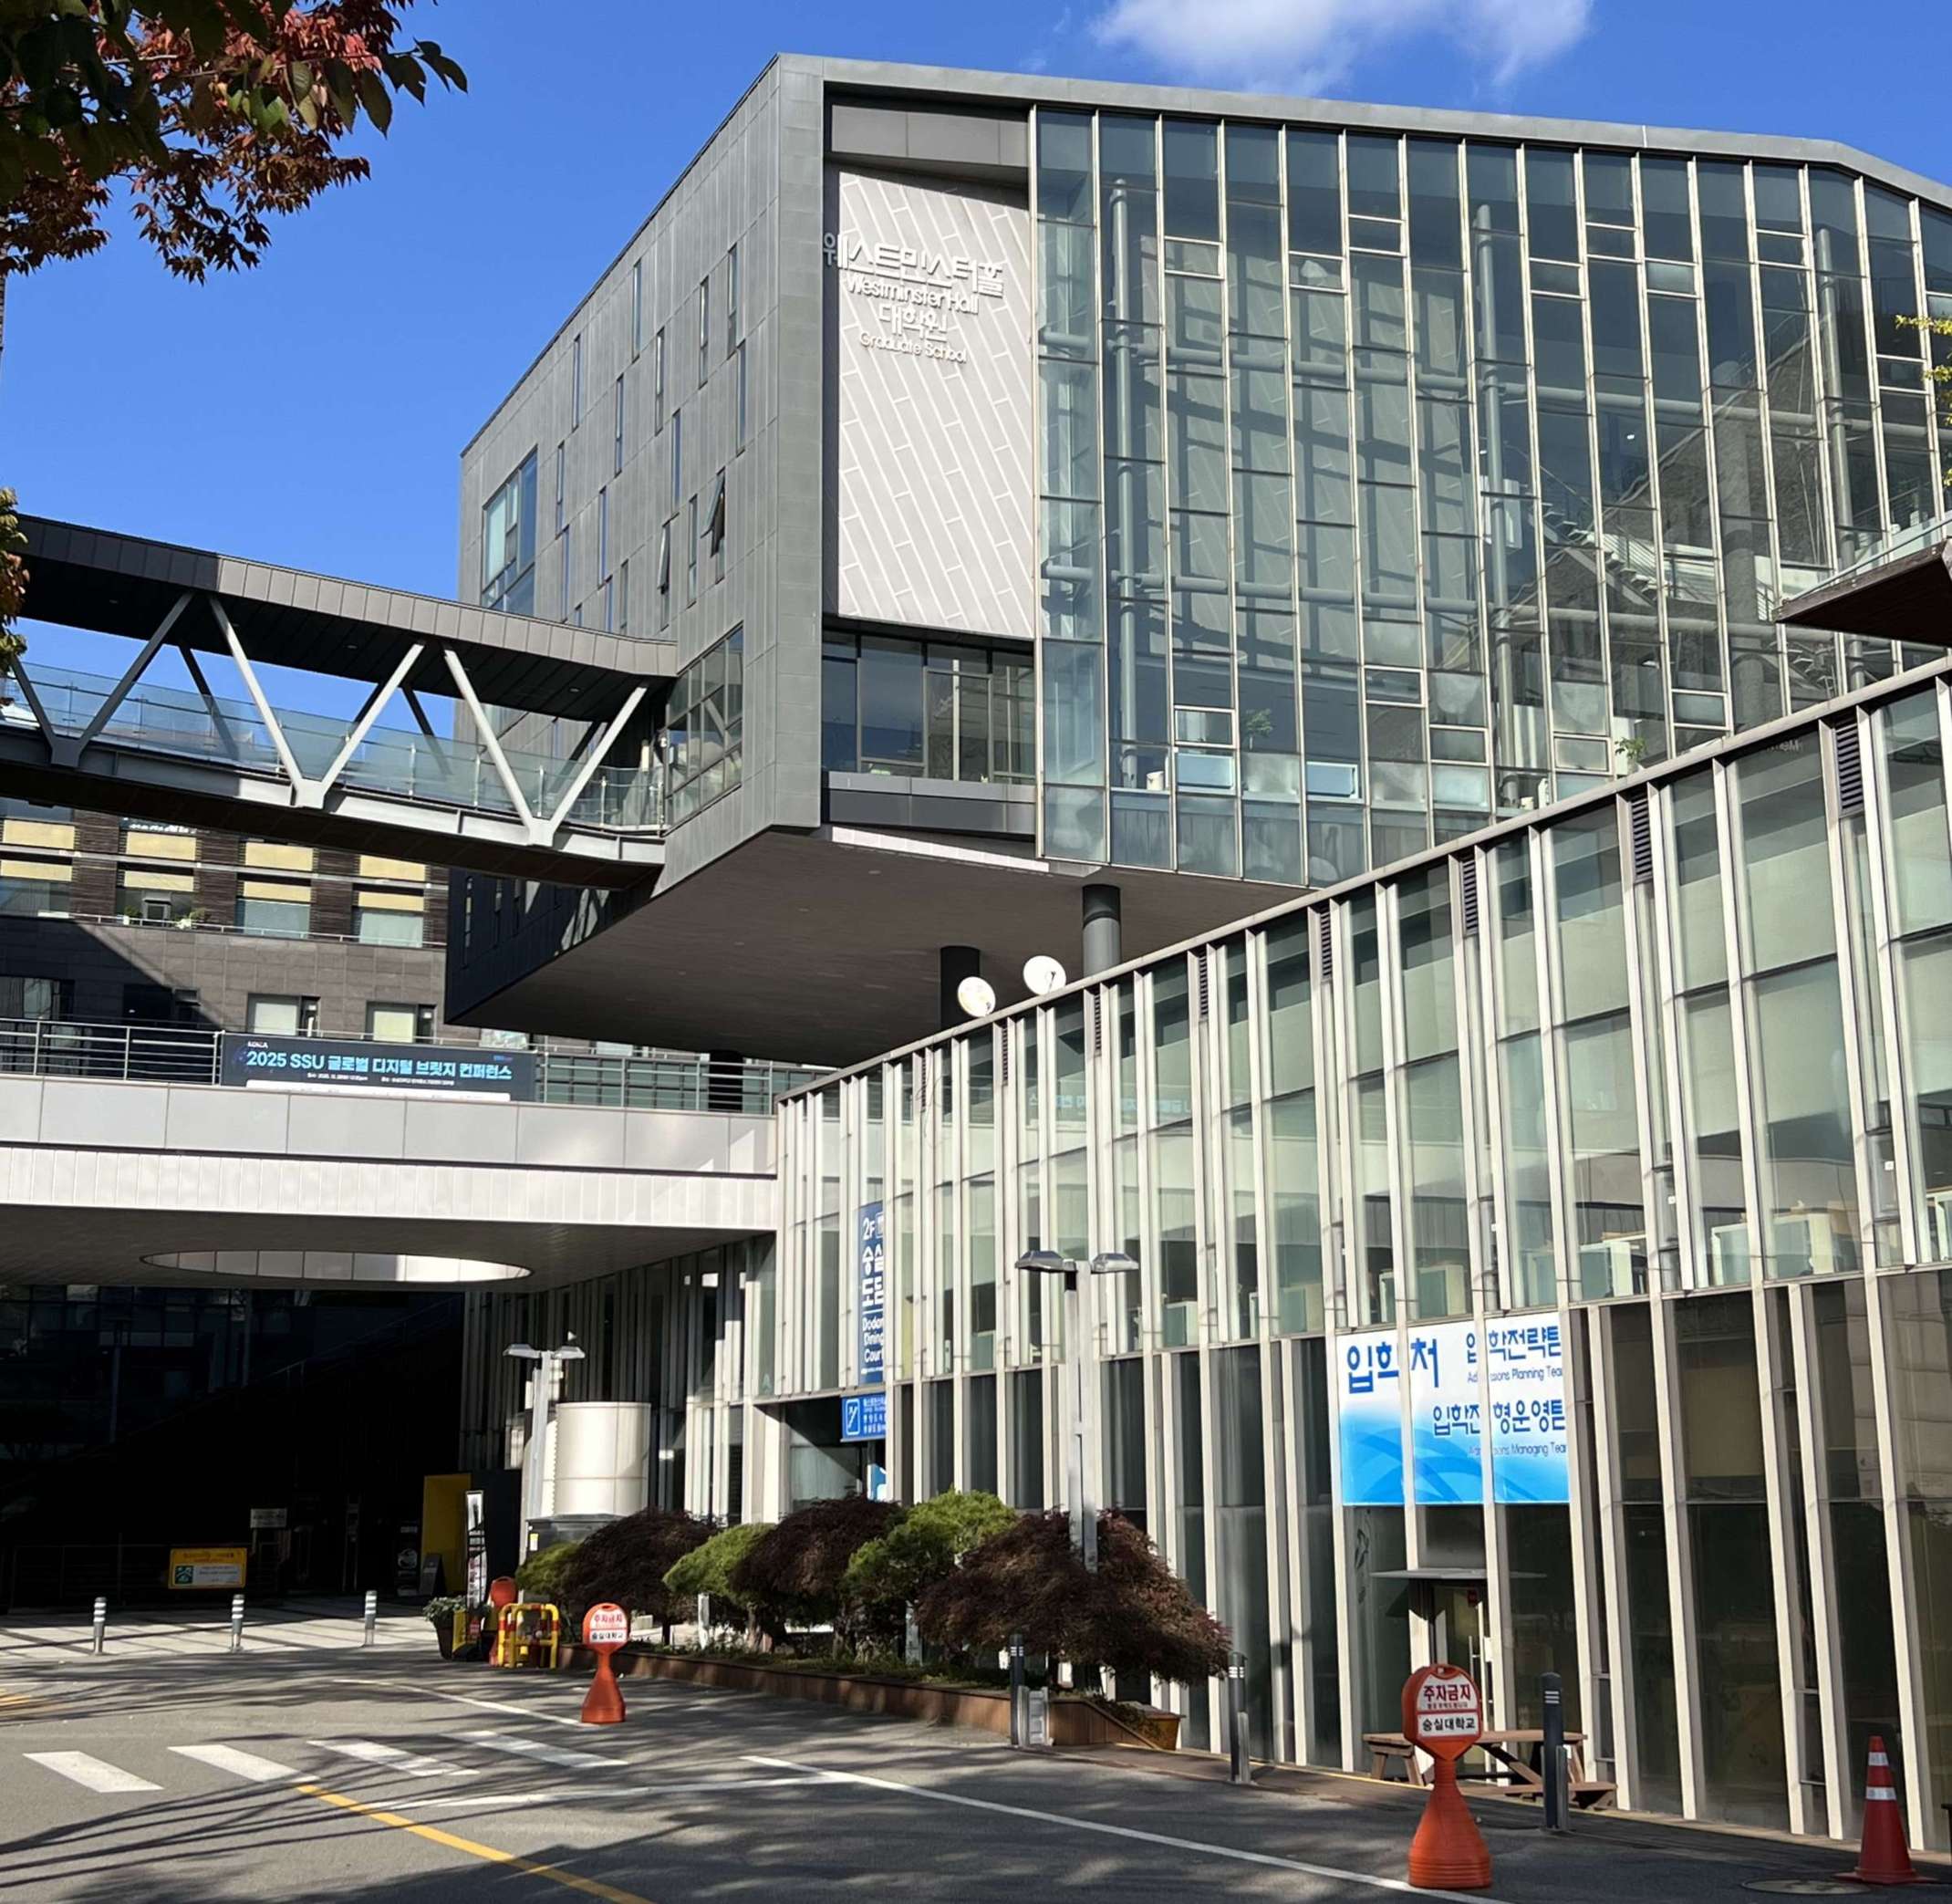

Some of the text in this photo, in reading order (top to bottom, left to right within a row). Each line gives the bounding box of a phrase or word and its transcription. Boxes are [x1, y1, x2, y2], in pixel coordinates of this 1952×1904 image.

[824, 232, 1003, 299] 웨스트민스터홀
[845, 272, 978, 316] Westminster Hall
[877, 301, 947, 344] 대학원
[860, 332, 967, 365] Graduate School
[246, 1051, 513, 1081] 2025 SSU 글로벌 디지털 브릿지 컨퍼런스
[1511, 1367, 1544, 1381] Planning
[1545, 1365, 1562, 1378] Tea
[1511, 1442, 1548, 1458] Managing
[1423, 1683, 1471, 1702] 주차금지
[1422, 1717, 1475, 1732] 숭실대학교
